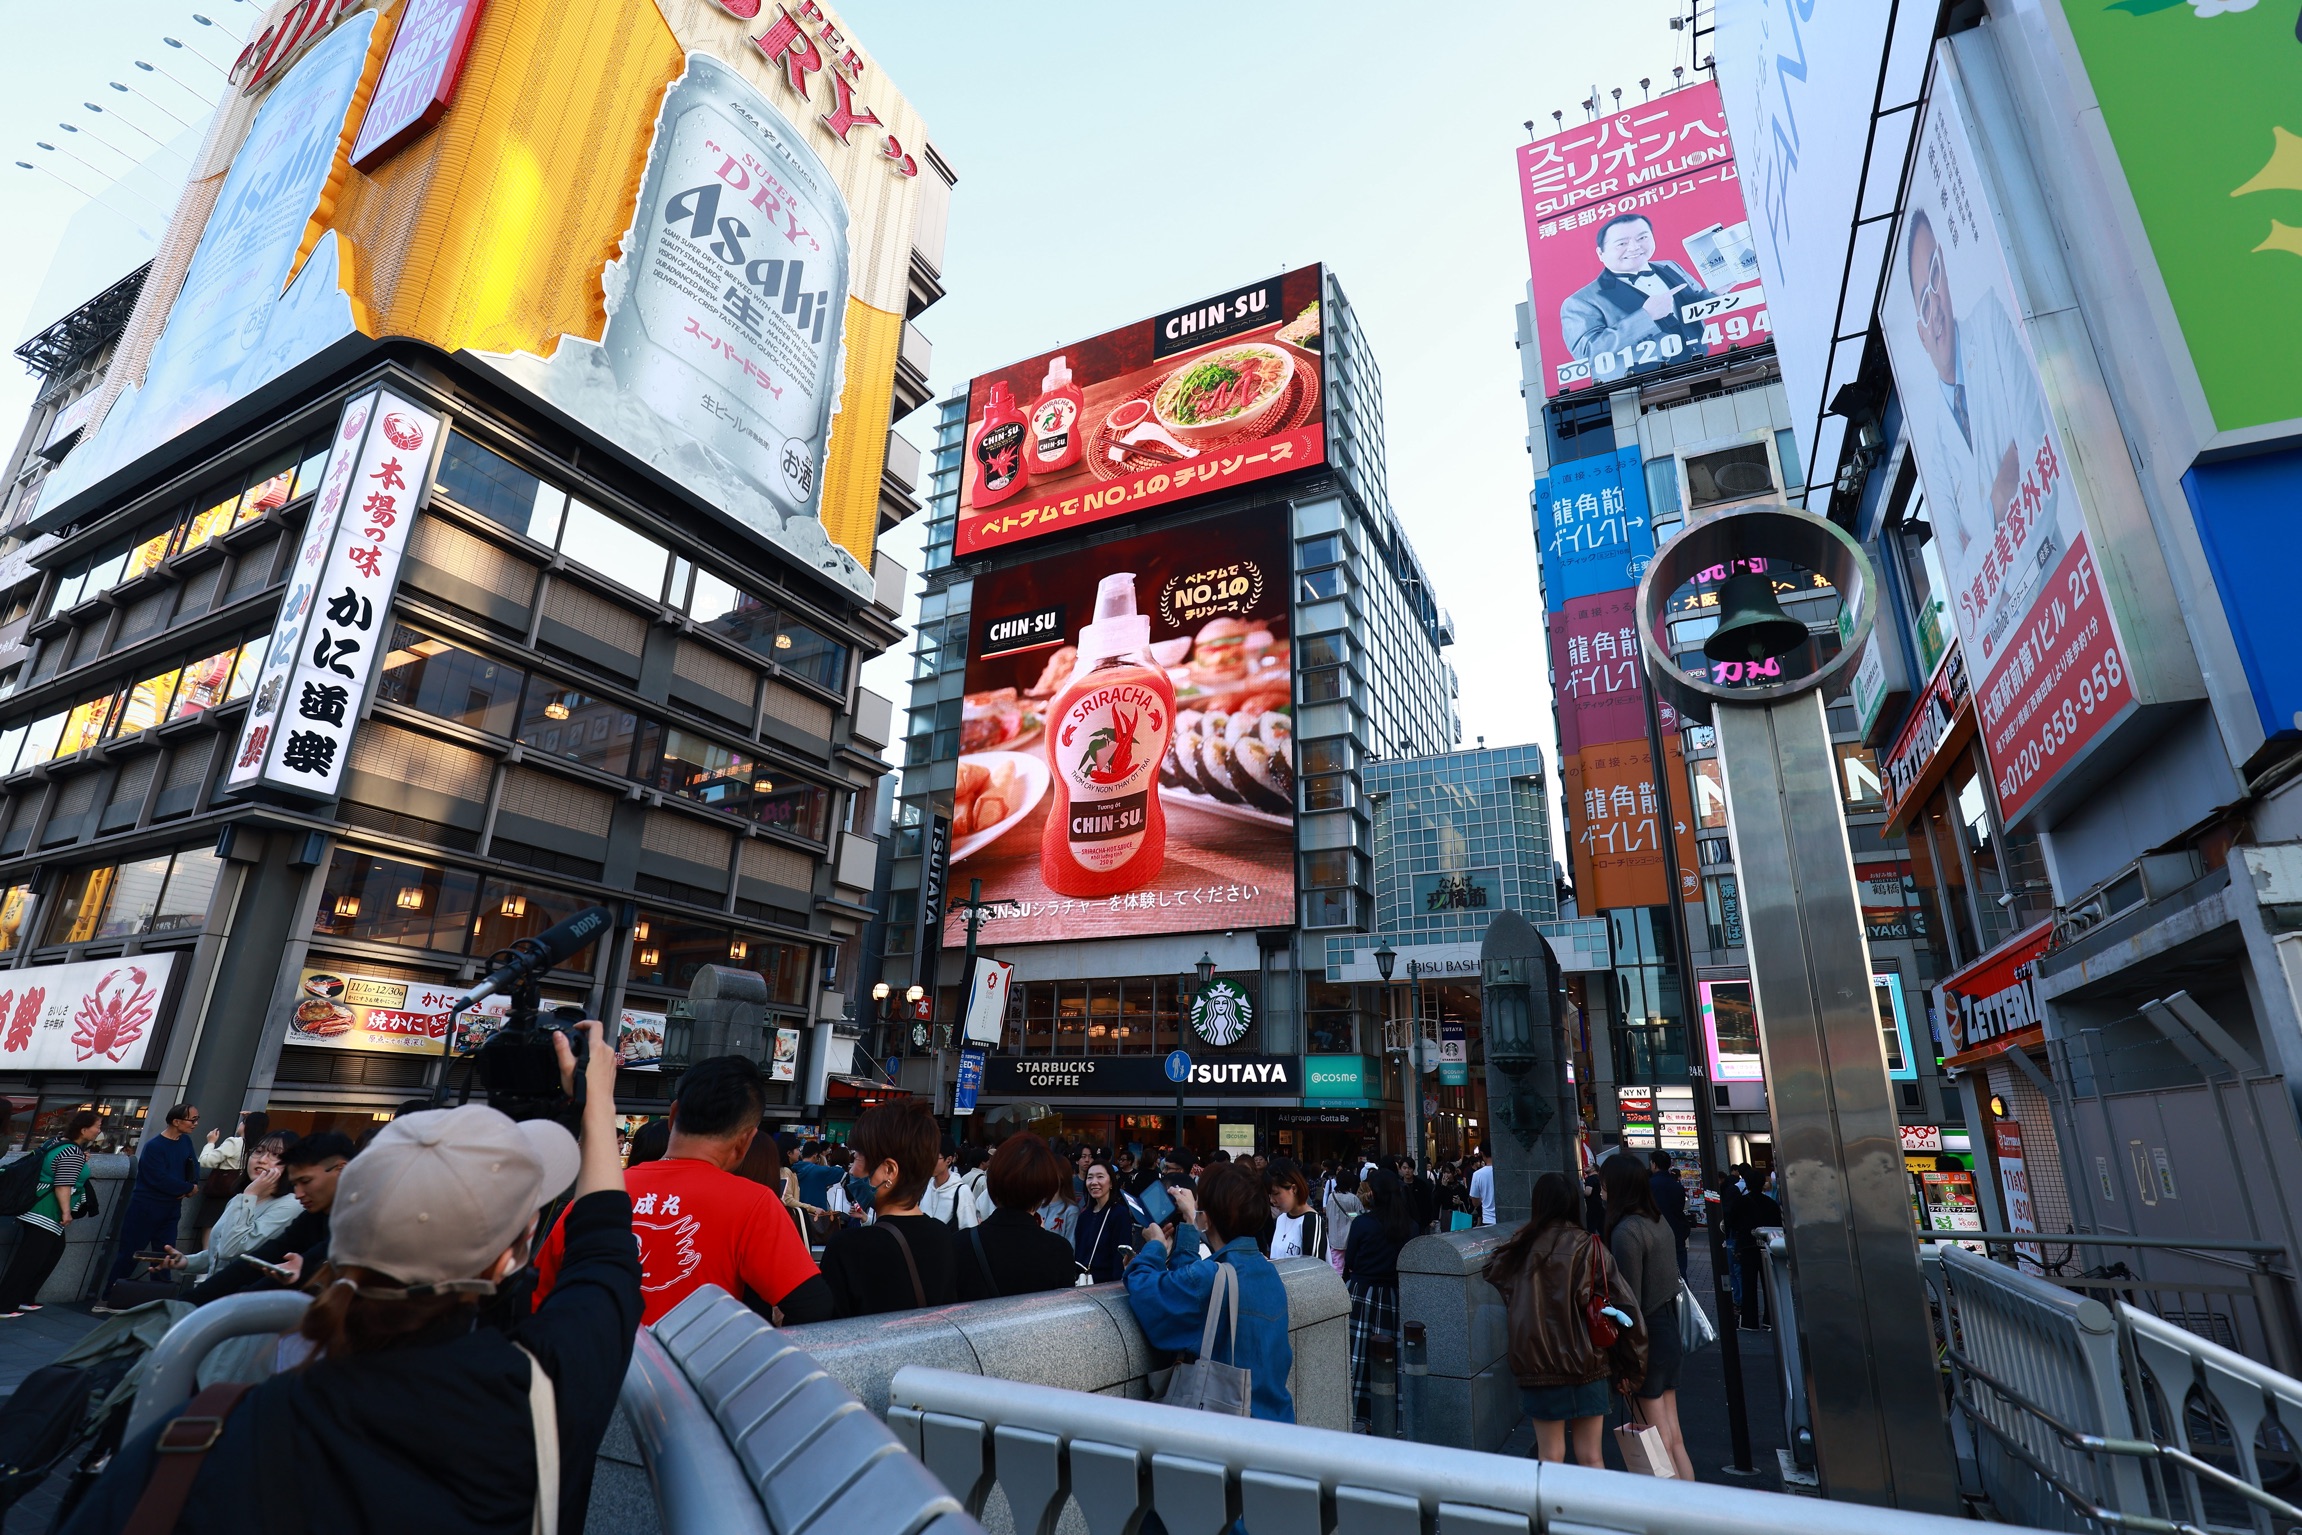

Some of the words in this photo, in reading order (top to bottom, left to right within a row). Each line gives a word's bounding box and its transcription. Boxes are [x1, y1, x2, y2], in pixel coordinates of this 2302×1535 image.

[378, 6, 462, 98] 1889
[357, 60, 440, 152] OSAKA
[1528, 110, 1670, 173] スーパー
[740, 152, 799, 212] SUPER
[1534, 177, 1620, 218] SUPER
[1627, 143, 1728, 187] MILLION
[1538, 165, 1739, 240] 薄毛部分のボリューム
[660, 237, 684, 256] QUALITY
[665, 183, 828, 345] Asahi
[656, 258, 669, 270] OUR
[665, 263, 698, 289] ADVANCED
[658, 246, 679, 264] VISION
[685, 264, 720, 293] JAPANESE
[663, 227, 681, 242] ASAHI
[681, 238, 701, 256] SUPER
[701, 252, 717, 267] DRY
[724, 270, 752, 295] BREWED
[753, 293, 771, 312] WITH
[771, 310, 802, 340] PRECISION
[801, 338, 808, 348] TO
[653, 269, 678, 290] DELIVER
[698, 298, 719, 316] CRISP
[718, 311, 741, 333] TASTE
[740, 330, 758, 346] AND
[780, 363, 798, 383] CLEAN
[722, 286, 765, 339] 生
[1165, 288, 1267, 340] CHIN-SU
[1688, 297, 1740, 320] ルアン
[766, 329, 793, 355] MASTER
[768, 318, 791, 342] UNDER
[791, 340, 803, 353] THE
[1594, 309, 1772, 376] 0120-494
[683, 316, 783, 401] スーパードライ
[765, 338, 778, 353] ING
[778, 351, 814, 389] TECHNIQUES
[982, 425, 1020, 447] CHIN-SU
[1039, 438, 1066, 451] CHIN-SU
[14, 490, 39, 523] 7F
[348, 456, 407, 580] 本場の味
[1552, 486, 1626, 527] 龍角散
[1549, 516, 1630, 558] ダイレクト
[1971, 433, 2062, 620] 東京美容外科
[2038, 542, 2051, 565] 検索
[1175, 576, 1249, 609] NO.1の
[1185, 564, 1239, 585] ベトナムで
[989, 612, 1056, 642] CHIN-SU
[1185, 600, 1239, 621] チリソース
[1991, 610, 2010, 647] YouTube
[1983, 597, 2067, 733] 大阪駅前第1ビル
[2068, 552, 2092, 611] 2F
[1686, 669, 1706, 678] OPEN
[1073, 686, 1153, 723] SRIRACHA
[2005, 646, 2123, 795] 0120-658-958
[1891, 695, 1951, 805] ZETTERIA
[1072, 808, 1141, 834] CHIN-SU
[925, 826, 946, 925] TSUTAYA
[1438, 875, 1473, 888] なんば
[1872, 882, 1901, 895] 鶴橋
[1426, 886, 1487, 911] 戎橋筋
[1719, 883, 1744, 941] 焼きそば
[569, 912, 602, 938] RØDE
[366, 1012, 424, 1032] 焼かに
[1016, 1062, 1095, 1074] STARBUCKS
[1029, 1075, 1080, 1086] COFFEE
[1187, 1063, 1287, 1083] TSUTAYA
[1311, 1072, 1358, 1084] @cosme
[1623, 1089, 1635, 1097] NY
[1636, 1088, 1648, 1096] NY
[1291, 1115, 1311, 1123] group
